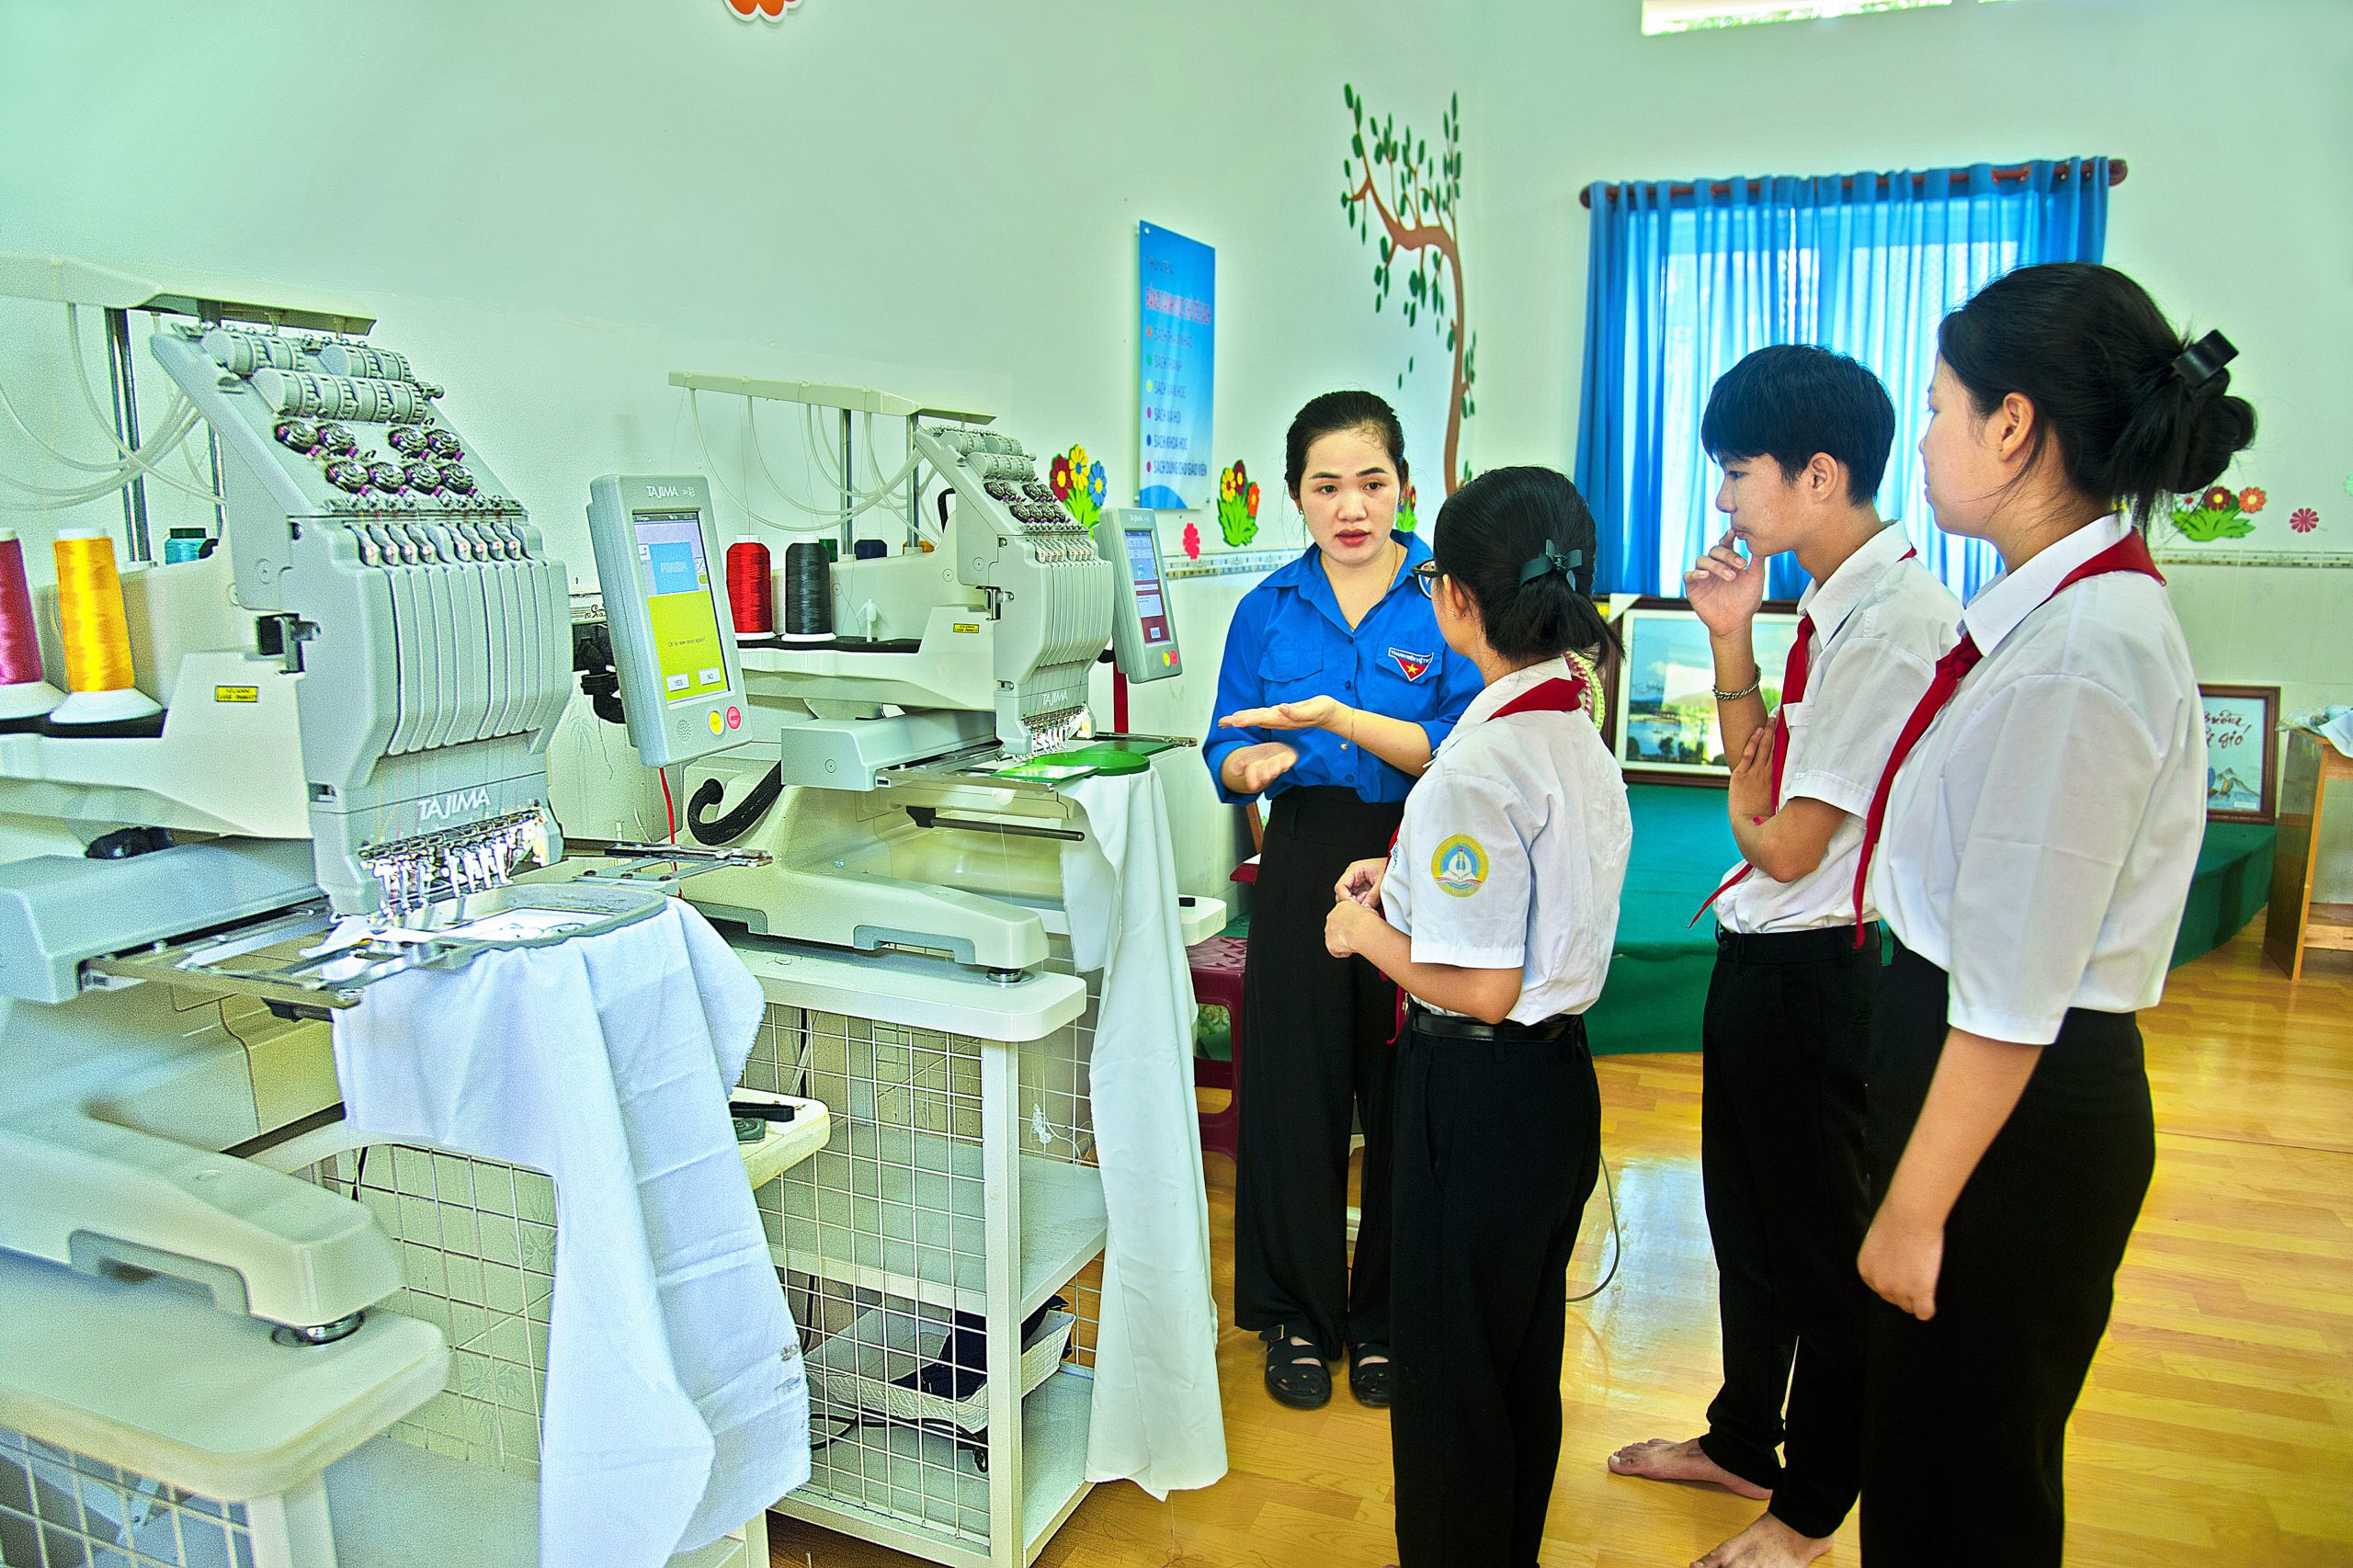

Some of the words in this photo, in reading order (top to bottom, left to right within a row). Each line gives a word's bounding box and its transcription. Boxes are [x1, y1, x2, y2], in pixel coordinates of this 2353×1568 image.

[646, 485, 679, 499] TAJIMA
[1042, 690, 1068, 706] TAJIMA
[417, 787, 491, 820] TAJIMA
